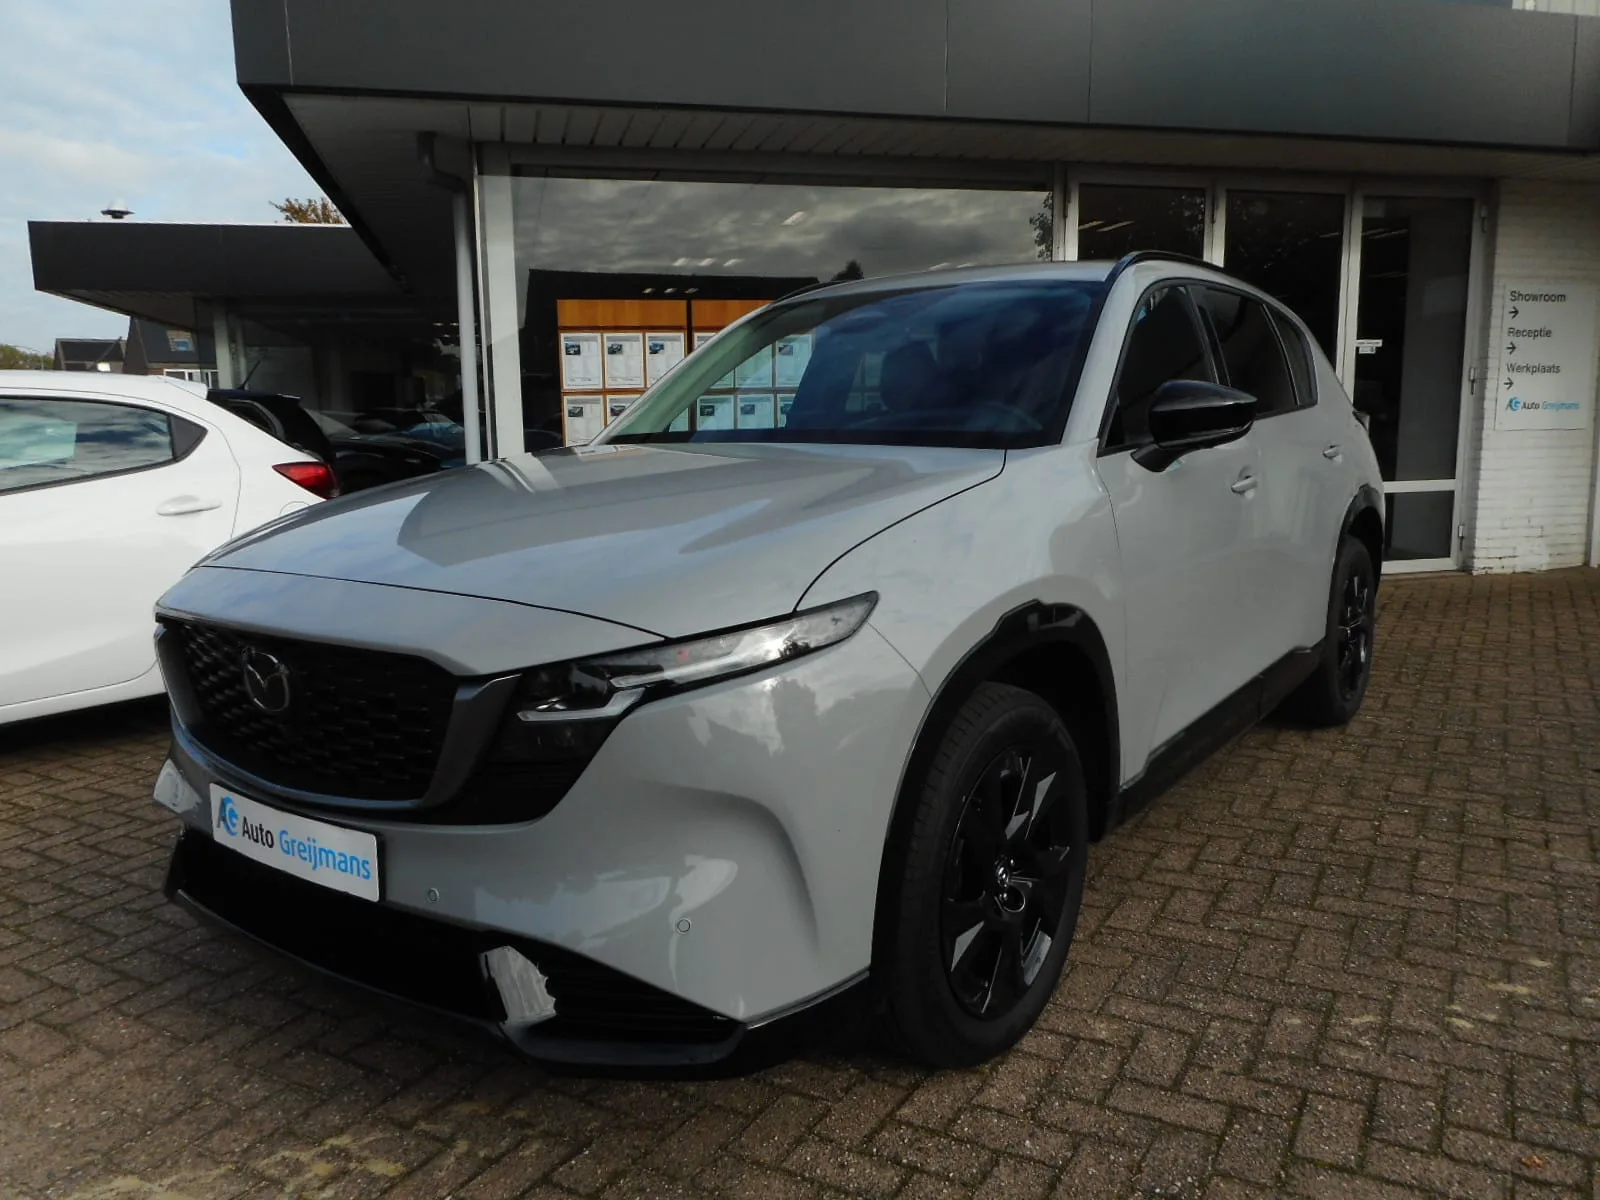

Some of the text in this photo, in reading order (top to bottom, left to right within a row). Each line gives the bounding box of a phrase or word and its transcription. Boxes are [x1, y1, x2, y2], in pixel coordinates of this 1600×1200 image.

[1510, 290, 1566, 302] Showroom
[1508, 327, 1552, 339] Receptie
[1507, 363, 1560, 375] Werkplaats
[1522, 401, 1540, 410] Auto
[242, 816, 274, 848] Auto
[279, 829, 371, 880] Greijmans
